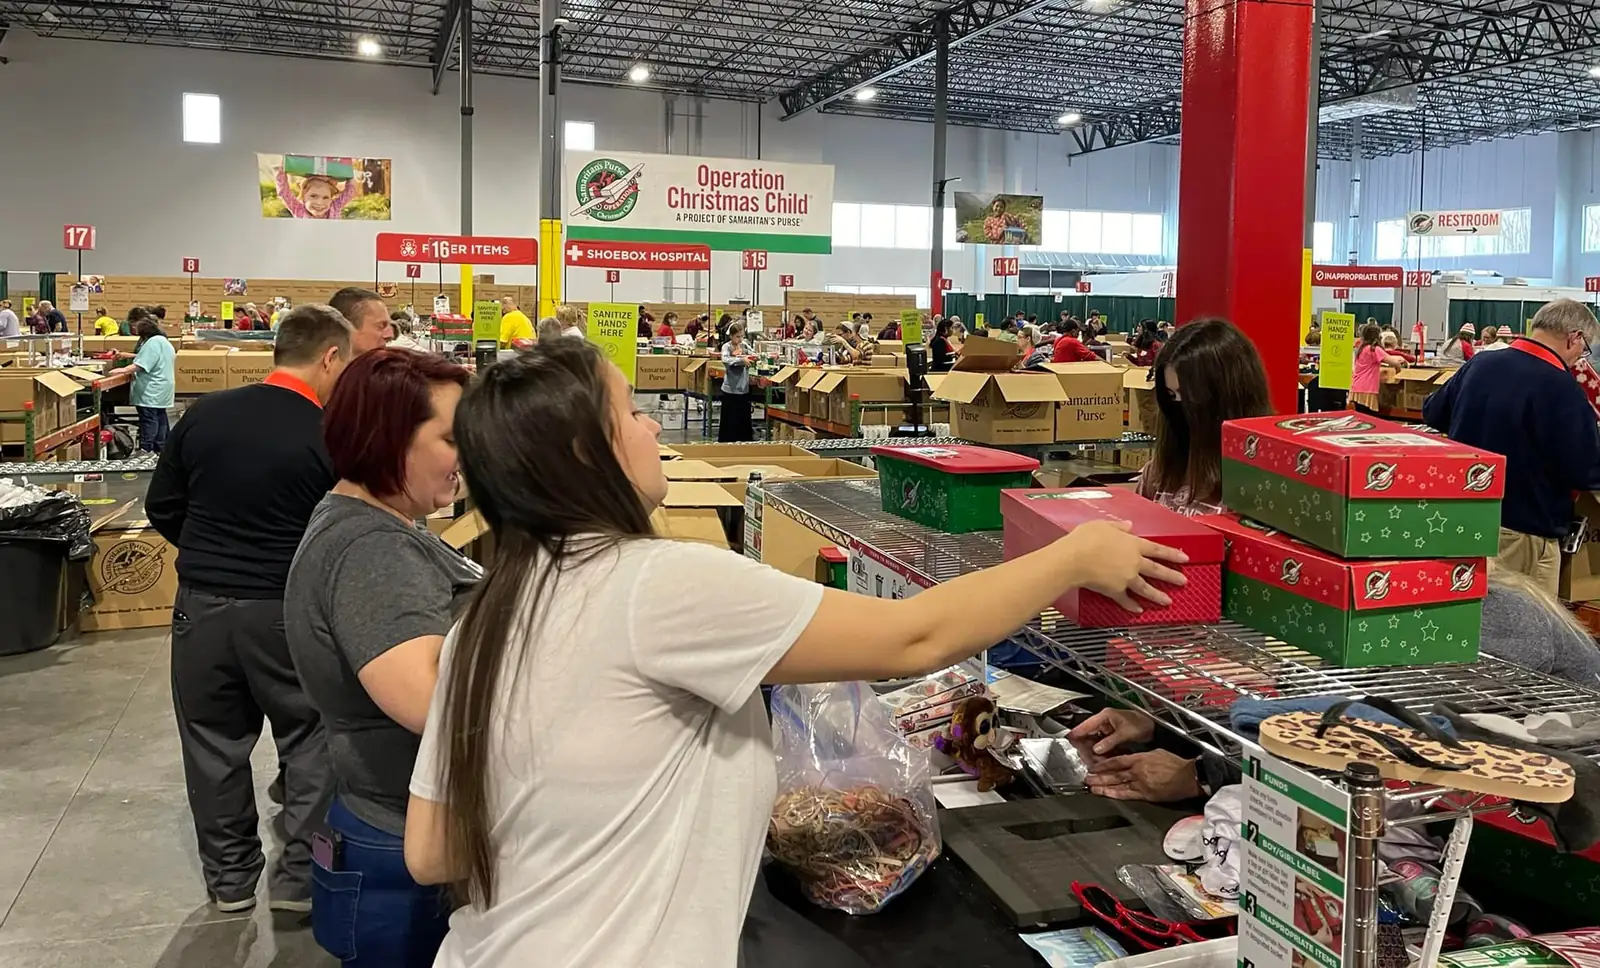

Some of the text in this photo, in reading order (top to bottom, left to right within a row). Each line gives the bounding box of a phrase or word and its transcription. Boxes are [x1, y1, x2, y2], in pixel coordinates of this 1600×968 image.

[604, 160, 626, 176] Purse
[698, 164, 785, 191] Operation
[667, 186, 808, 215] Christmas Child
[676, 213, 801, 227] A PROJECT OF SAMARITAN'S PURSE
[1438, 213, 1499, 227] RESTROOM
[66, 226, 89, 247] 17
[431, 240, 450, 259] 16
[471, 245, 510, 256] ITEMS
[587, 249, 709, 263] SHOEBOX HOSPITAL
[187, 260, 195, 272] 8
[751, 251, 766, 269] 15
[1004, 259, 1017, 275] 14
[410, 265, 417, 276] 7
[610, 271, 617, 282] 6
[1324, 272, 1399, 281] INAPPROPRIATE ITEMS
[785, 276, 791, 286] 5
[1407, 271, 1418, 286] 12
[1420, 271, 1432, 287] 12
[1587, 278, 1598, 291] 11
[1083, 282, 1090, 292] 3
[593, 309, 633, 320] SANITIZE
[597, 319, 627, 329] HANDS
[1325, 318, 1351, 327] SANITIZE
[1328, 325, 1348, 333] HANDS
[600, 328, 624, 337] HERE
[1329, 332, 1345, 341] HERE
[178, 366, 225, 375] Samaritan's
[191, 375, 213, 383] Purse
[959, 407, 980, 422] Purse
[1076, 409, 1107, 422] Purse
[1251, 760, 1258, 779] 1
[1264, 773, 1289, 793] FUNDS
[1249, 824, 1257, 845] 2
[1262, 839, 1296, 866] BOY/GIRL
[1296, 859, 1322, 881] LABEL
[1247, 894, 1255, 917] 3
[1260, 910, 1313, 953] INAPPROPRIATE
[1315, 946, 1338, 968] ITEMS
[1507, 946, 1536, 957] BOY
